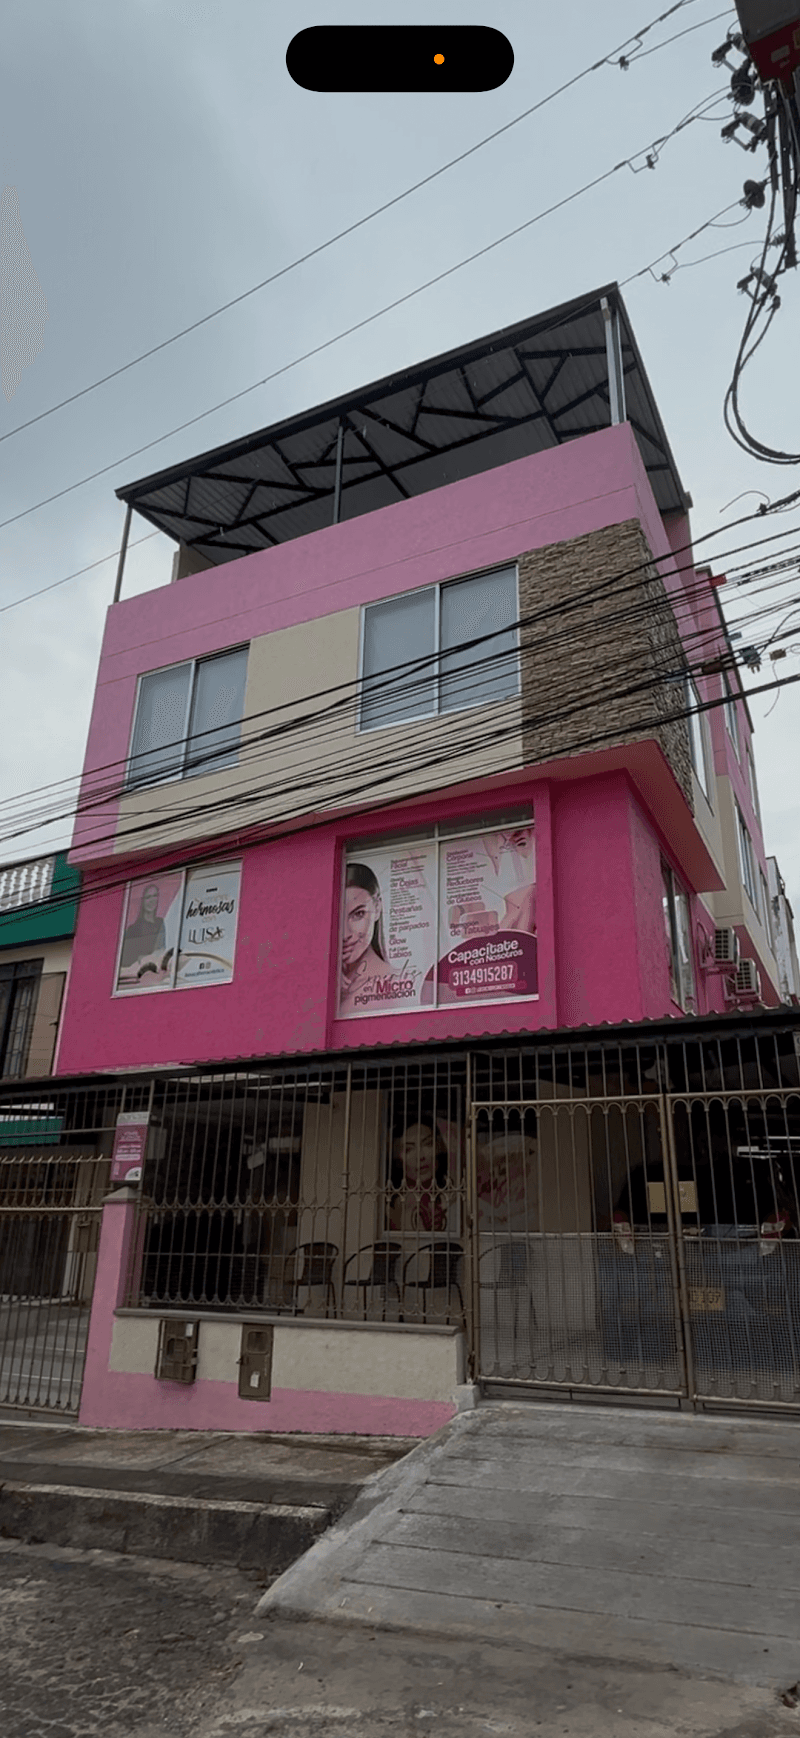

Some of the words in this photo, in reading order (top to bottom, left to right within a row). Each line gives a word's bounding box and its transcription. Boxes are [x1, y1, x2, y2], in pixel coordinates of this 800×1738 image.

[186, 899, 235, 919] hermosas
[450, 927, 461, 937] de
[469, 957, 485, 966] con
[485, 949, 523, 963] Nosotros
[452, 964, 514, 986] 3134915287
[376, 980, 414, 994] Micro
